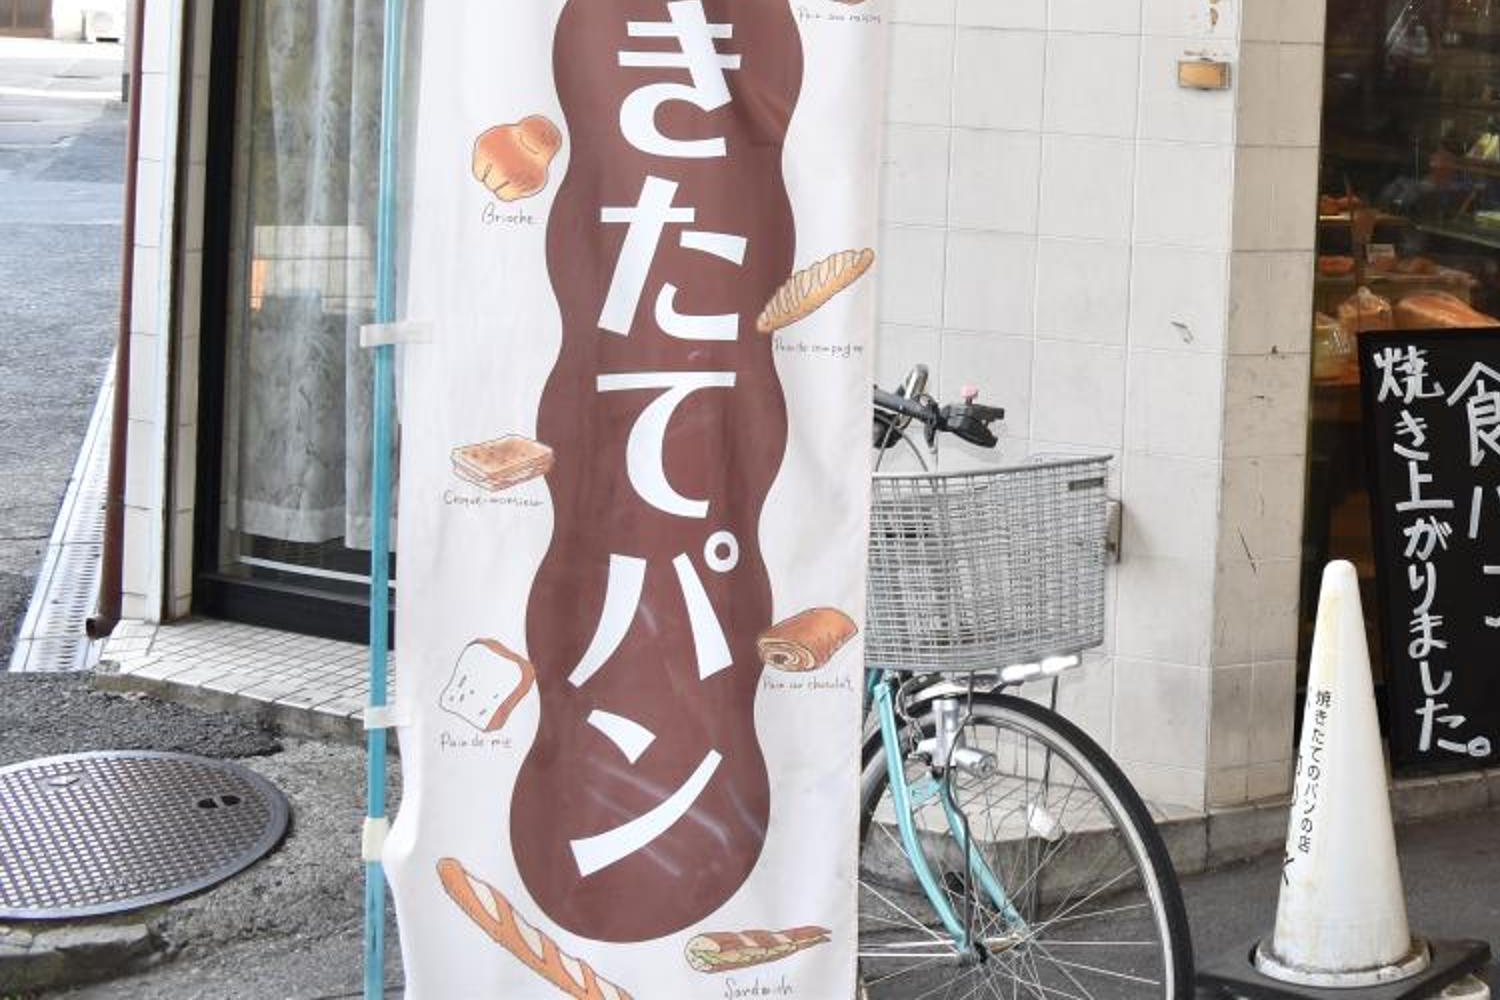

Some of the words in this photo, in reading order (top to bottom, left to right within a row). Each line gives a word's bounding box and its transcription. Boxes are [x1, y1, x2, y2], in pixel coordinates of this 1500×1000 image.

[1373, 345, 1491, 757] 焼き上がりました。
